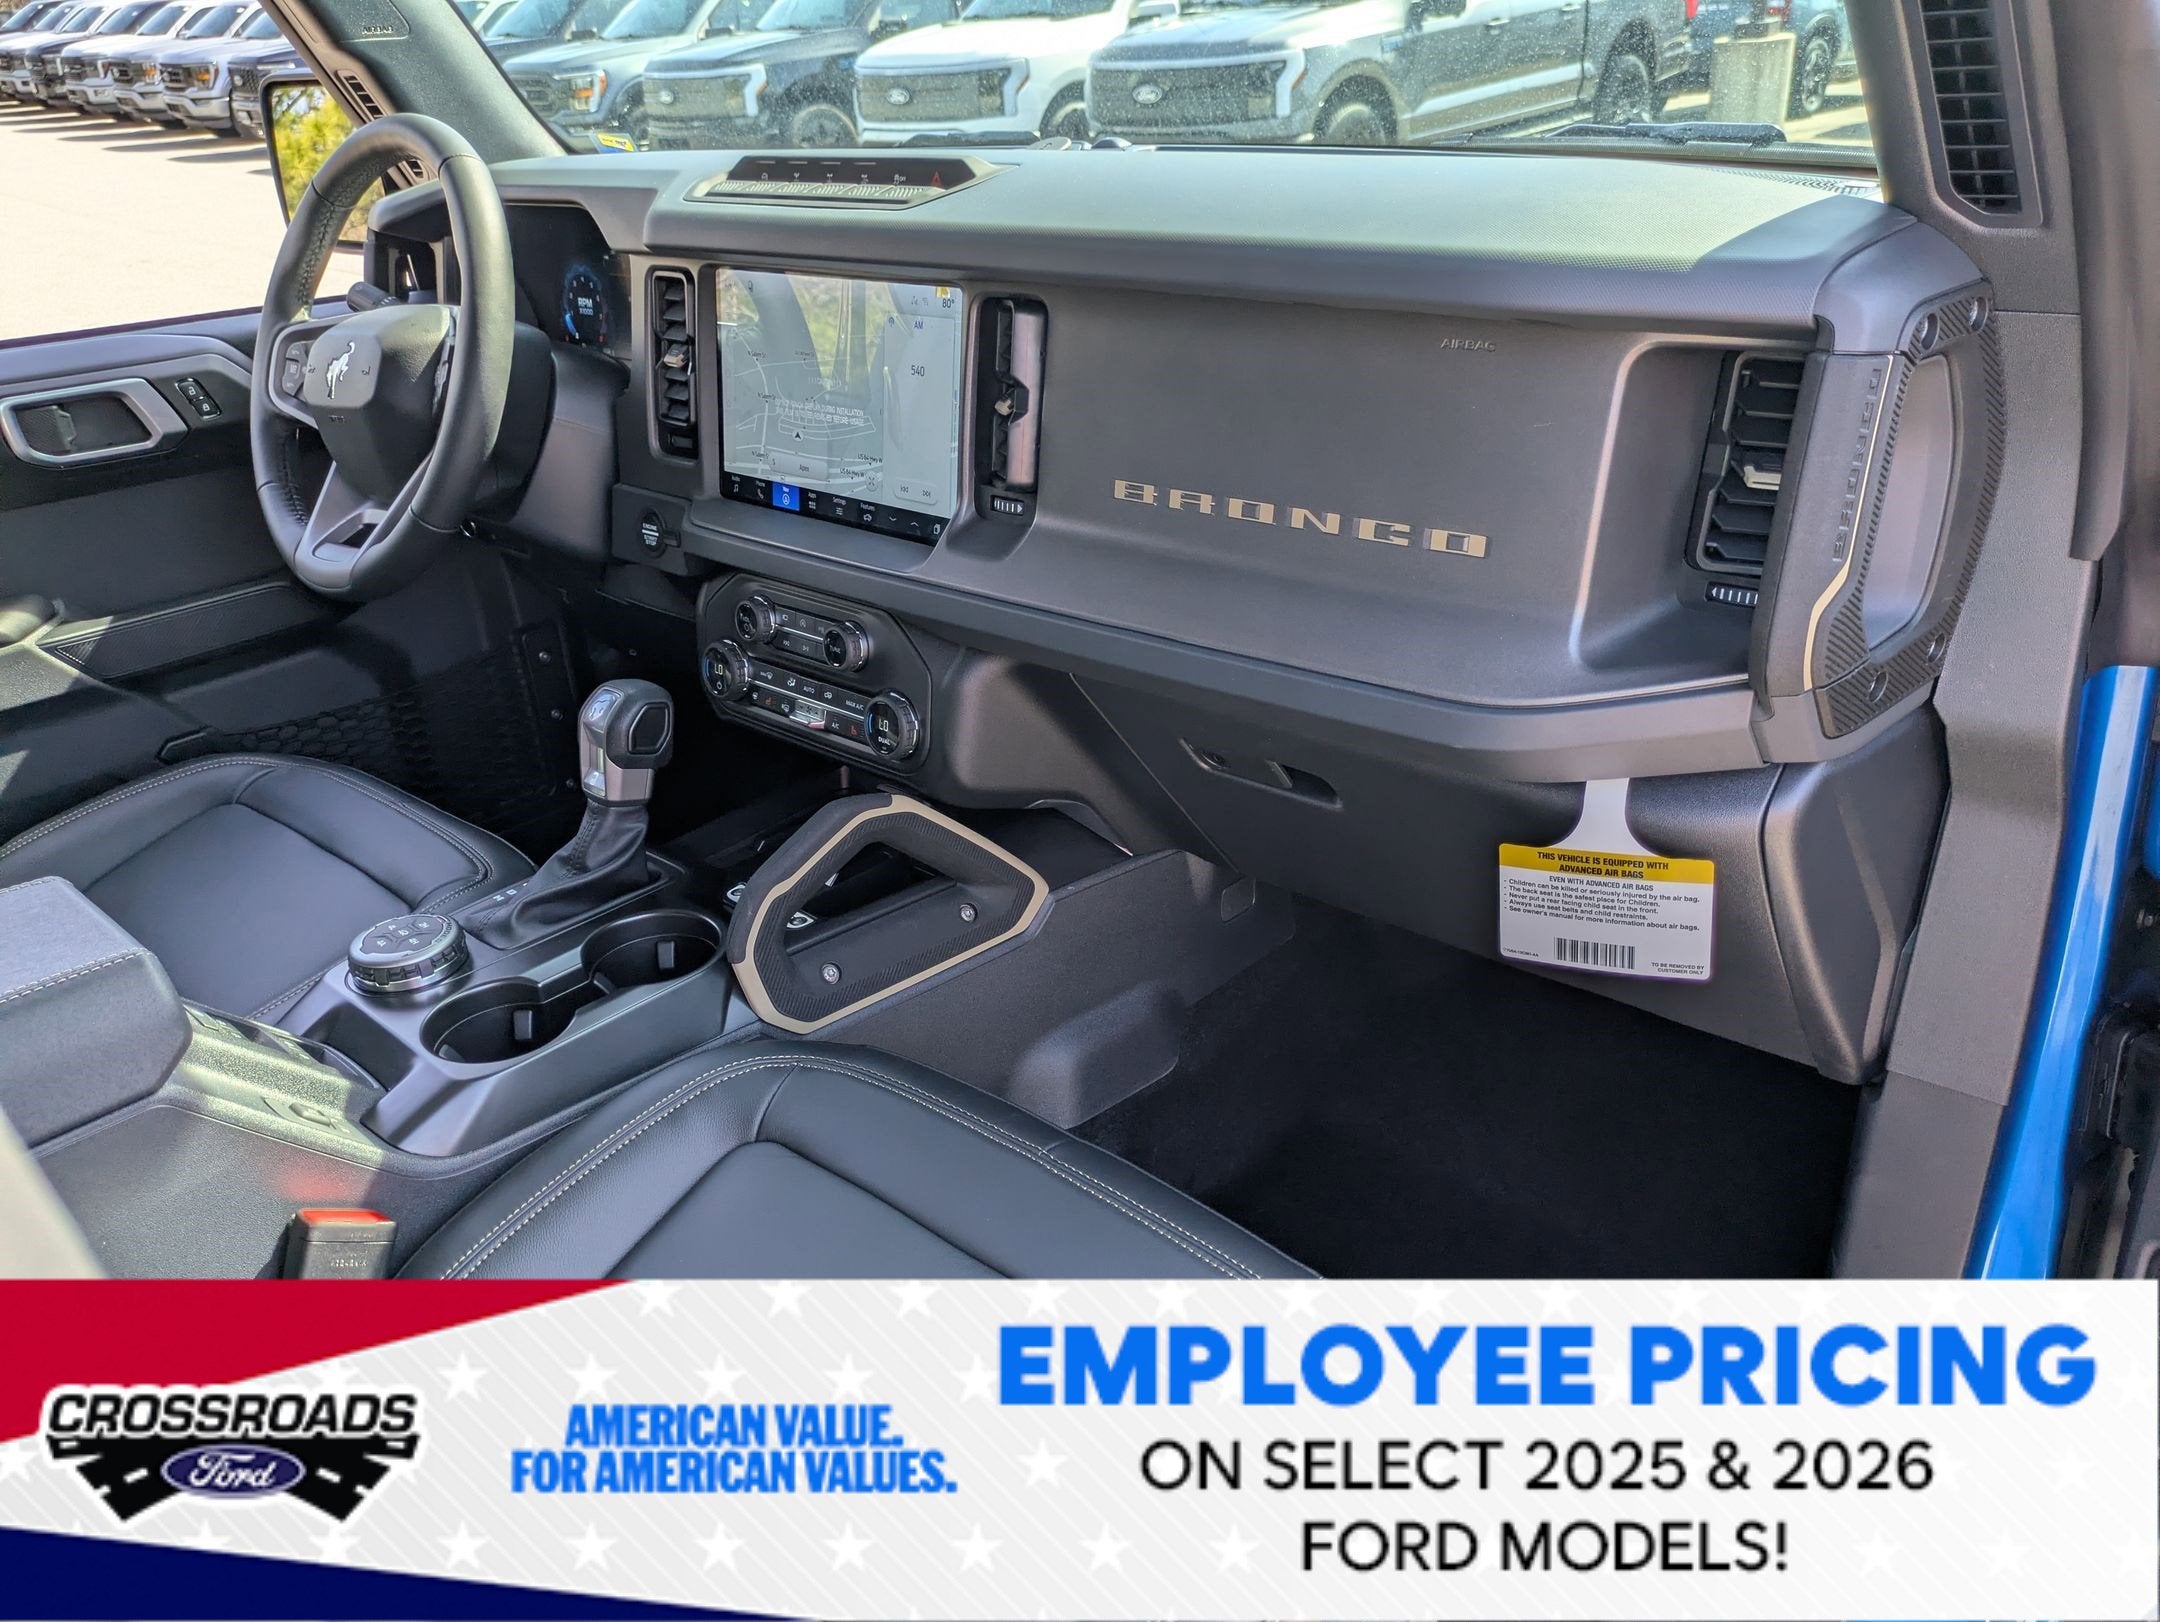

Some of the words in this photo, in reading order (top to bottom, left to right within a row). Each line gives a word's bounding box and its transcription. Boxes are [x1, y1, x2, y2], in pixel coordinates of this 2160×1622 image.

[914, 320, 924, 330] AM
[1440, 338, 1496, 352] AIRBAG
[911, 364, 925, 376] 540
[1113, 479, 1488, 558] BRONCO
[1537, 852, 1555, 860] THIS
[1557, 854, 1590, 864] VEHICLE
[1603, 858, 1644, 868] EQUIPPED
[1558, 864, 1602, 875] ADVANCED
[1604, 869, 1618, 877] AIR
[1621, 870, 1644, 879] BAGS
[1509, 878, 1536, 888] Children
[1561, 884, 1579, 893] killed
[1589, 889, 1620, 897] seriously
[1586, 879, 1620, 889] ADVANCED
[1509, 899, 1532, 907] Always
[1562, 905, 1578, 913] belts
[1562, 899, 1582, 907] facing
[1549, 912, 1573, 920] manual
[1605, 918, 1645, 927] information
